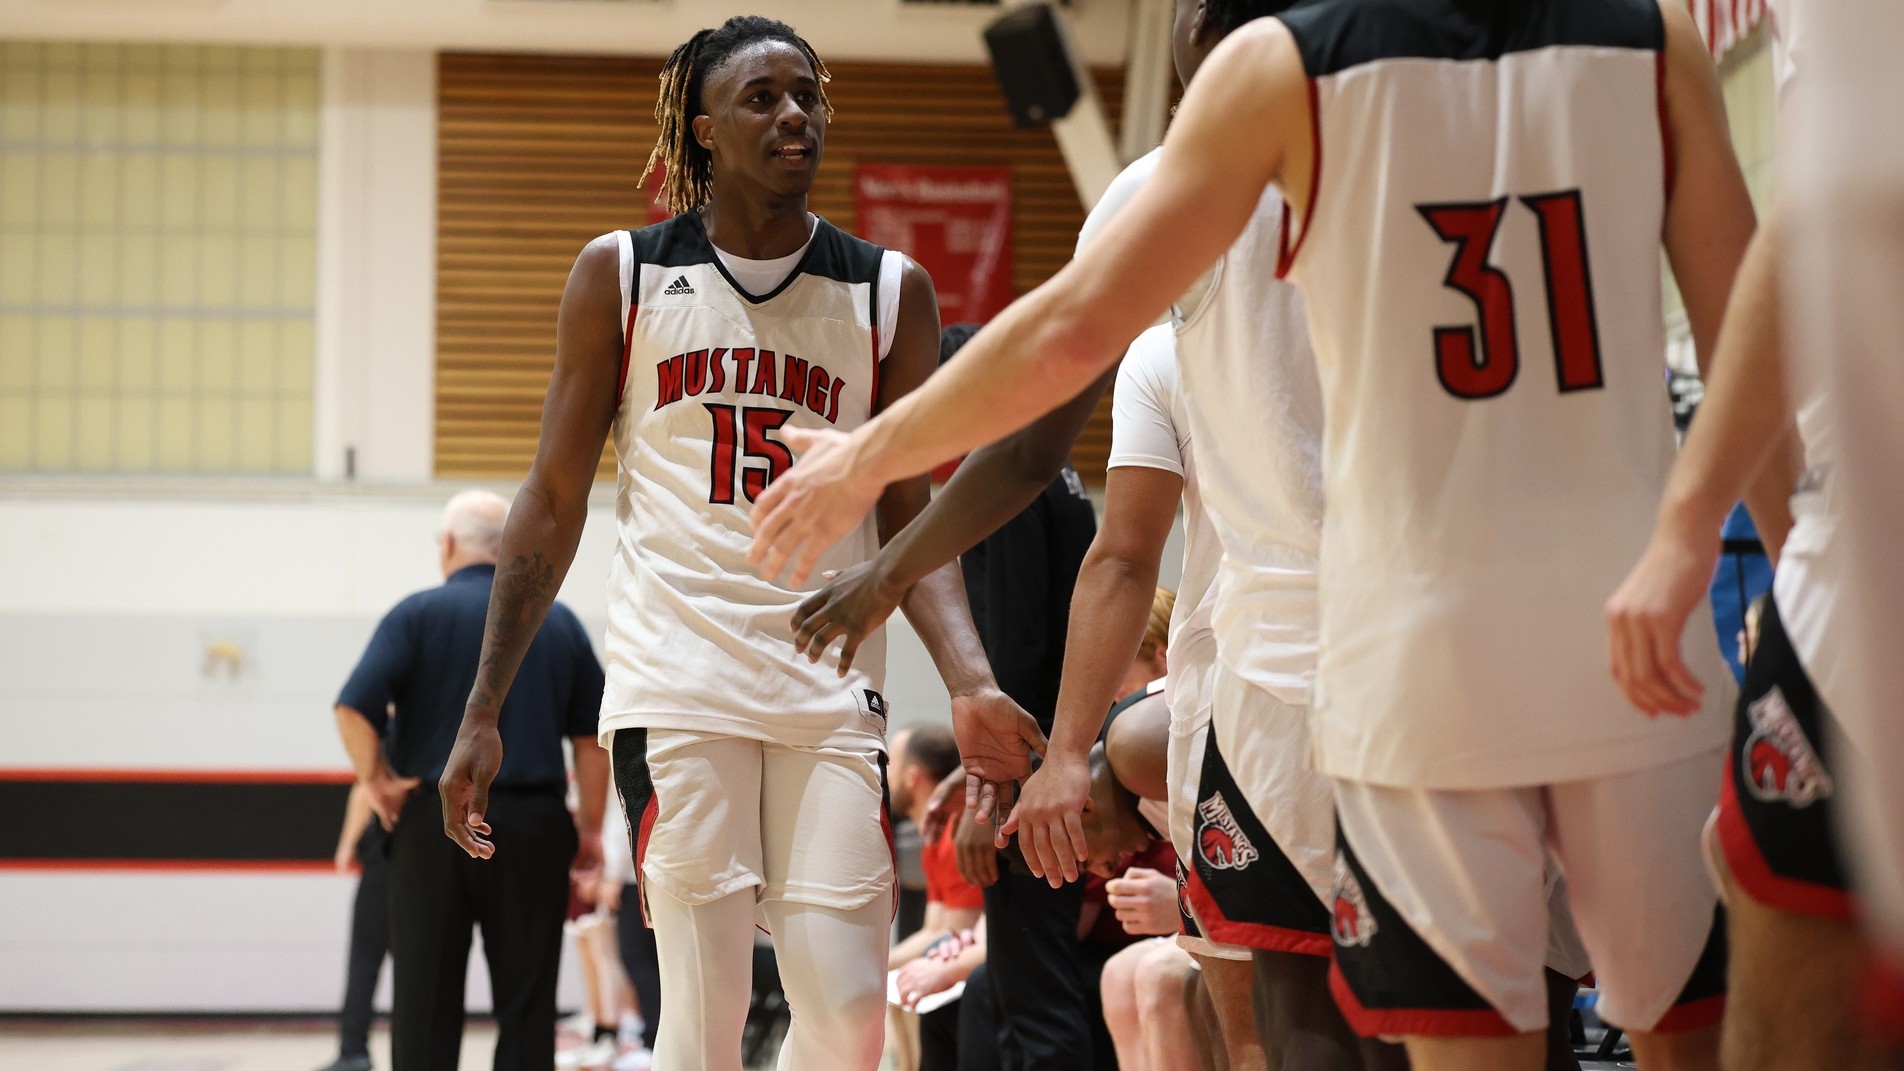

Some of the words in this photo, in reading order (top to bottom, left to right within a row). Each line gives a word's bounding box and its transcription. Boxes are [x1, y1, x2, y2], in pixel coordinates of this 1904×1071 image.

[663, 287, 695, 296] adidas
[1413, 188, 1605, 401] 31
[654, 347, 846, 424] MUSTANGS
[702, 402, 796, 505] 15
[1199, 790, 1258, 869] MUSTANGS
